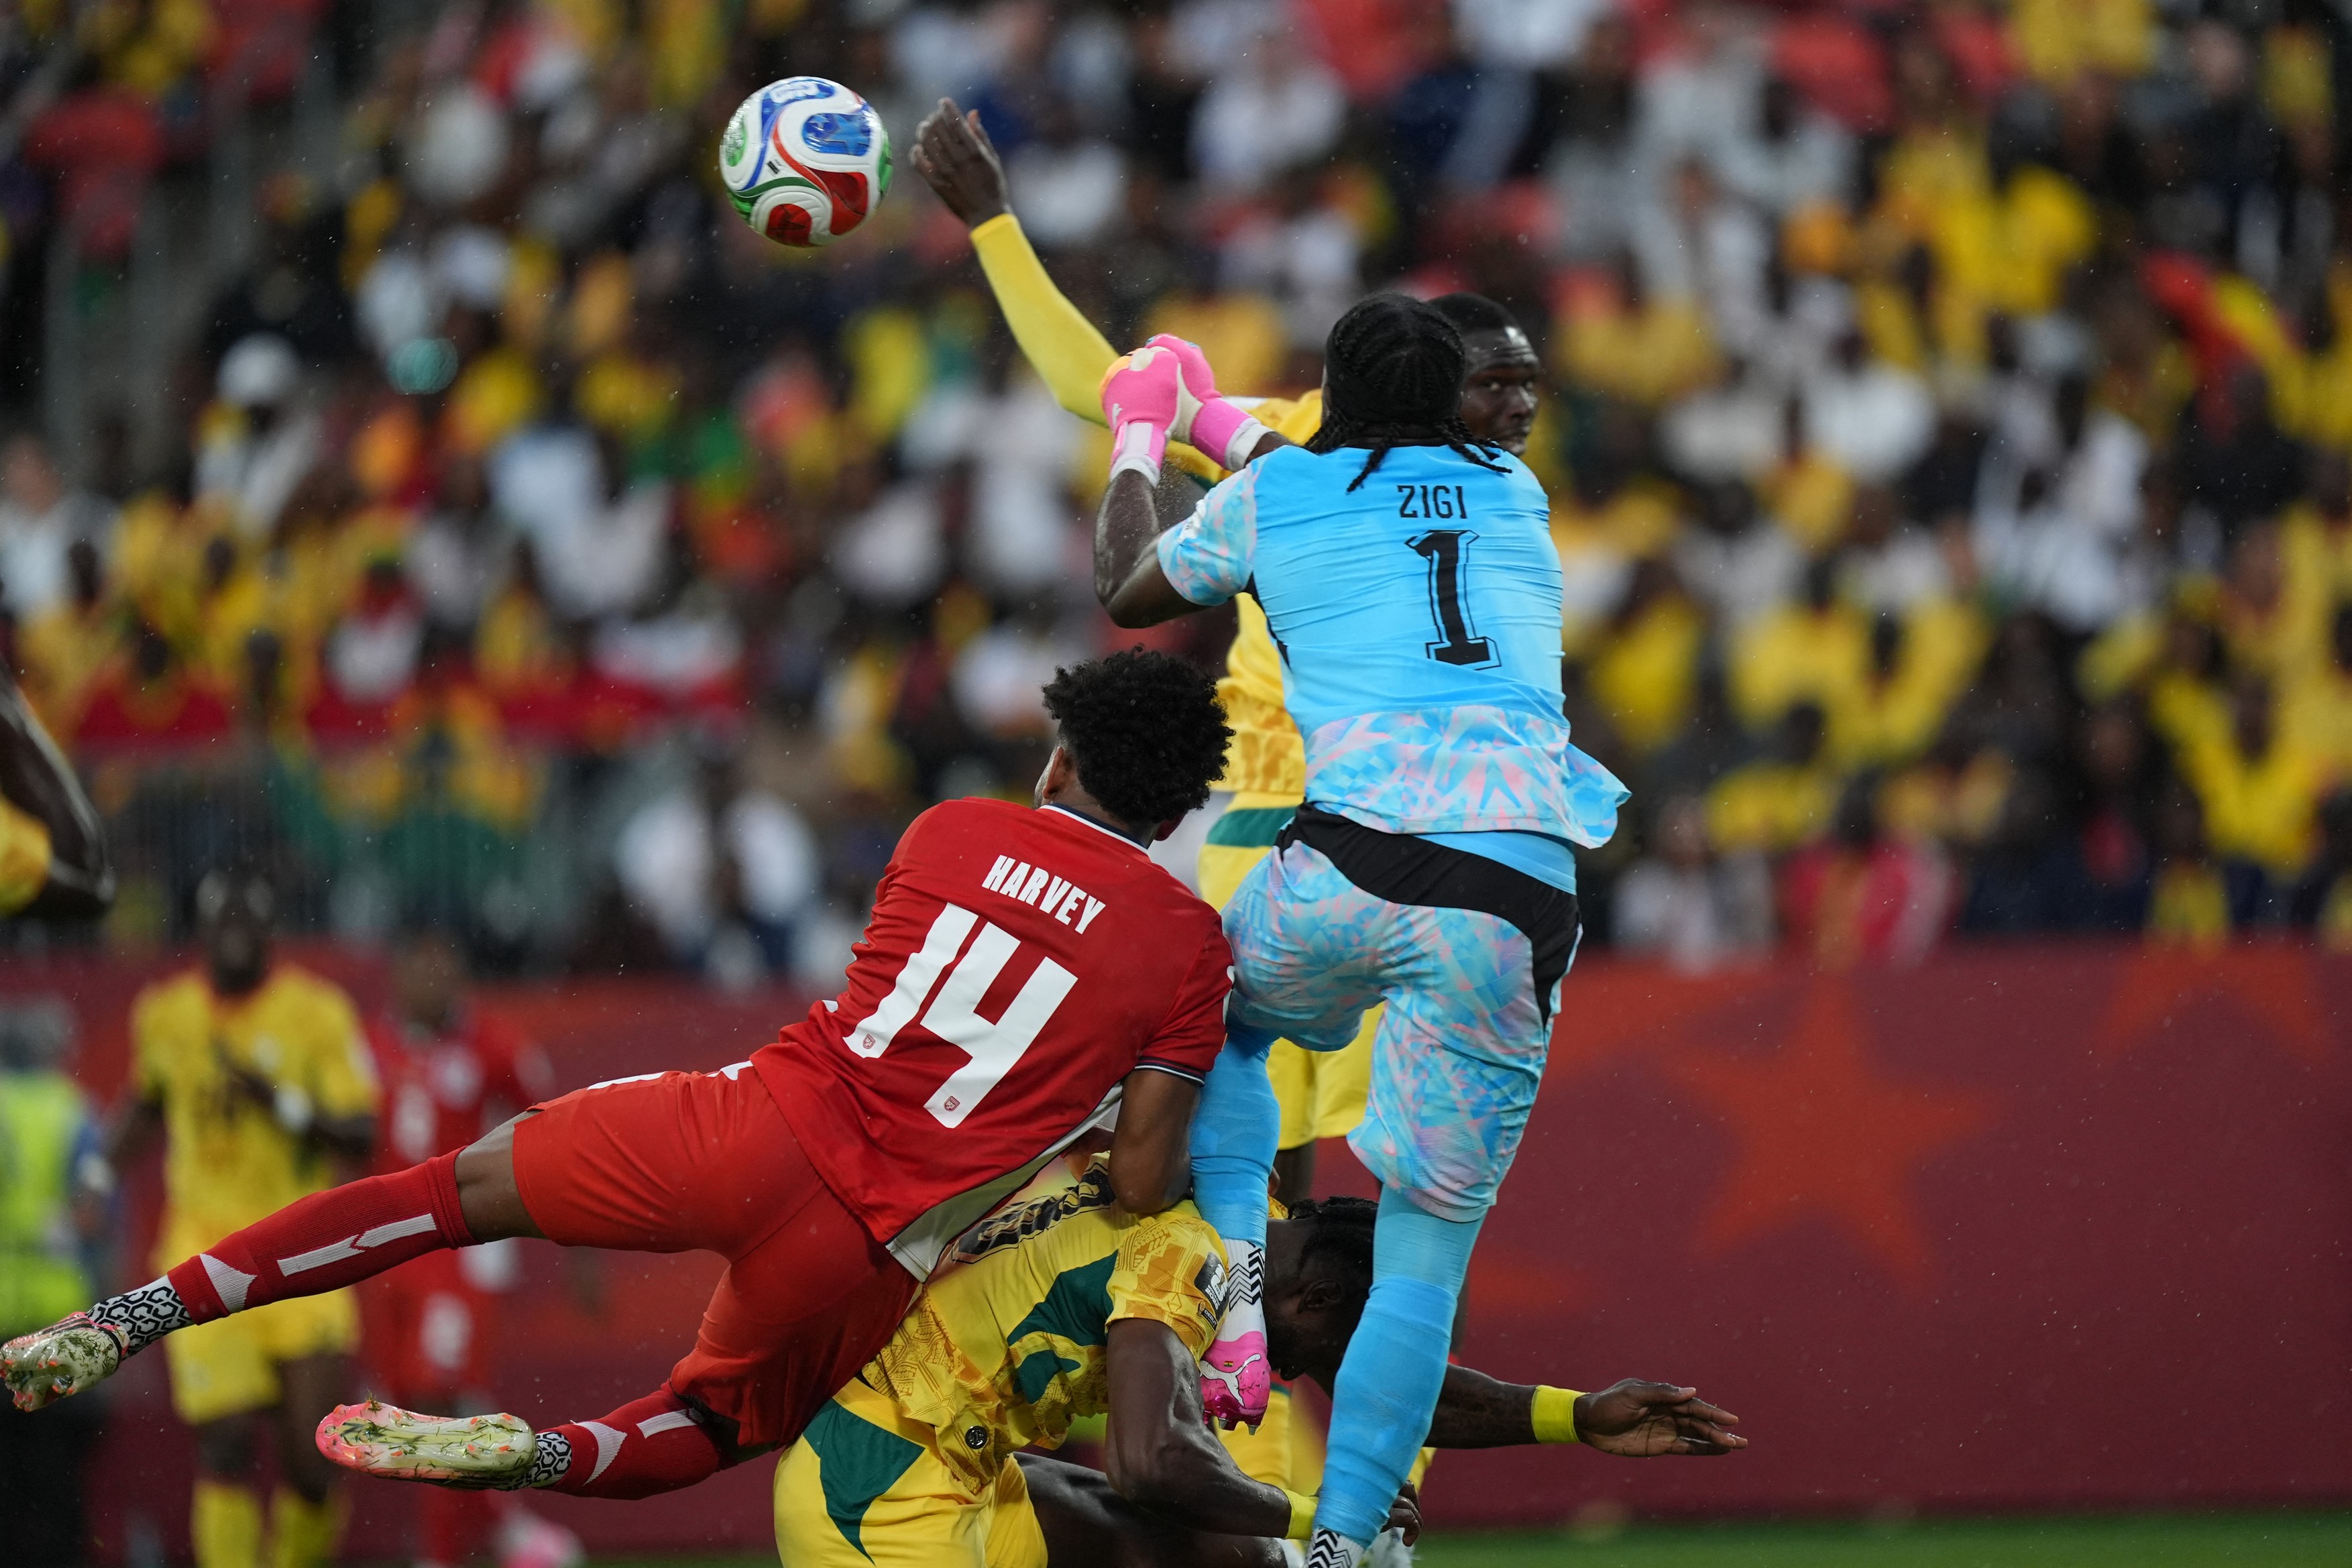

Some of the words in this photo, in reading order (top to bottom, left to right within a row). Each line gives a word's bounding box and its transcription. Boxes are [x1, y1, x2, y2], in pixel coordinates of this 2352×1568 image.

[1397, 485, 1467, 518] ZIGI
[1404, 530, 1502, 671] 1
[981, 854, 1107, 935] HARVEY
[842, 902, 1078, 1129] 14
[1204, 1309, 1217, 1325] DEBUT
[1205, 1286, 1218, 1310] 2026
